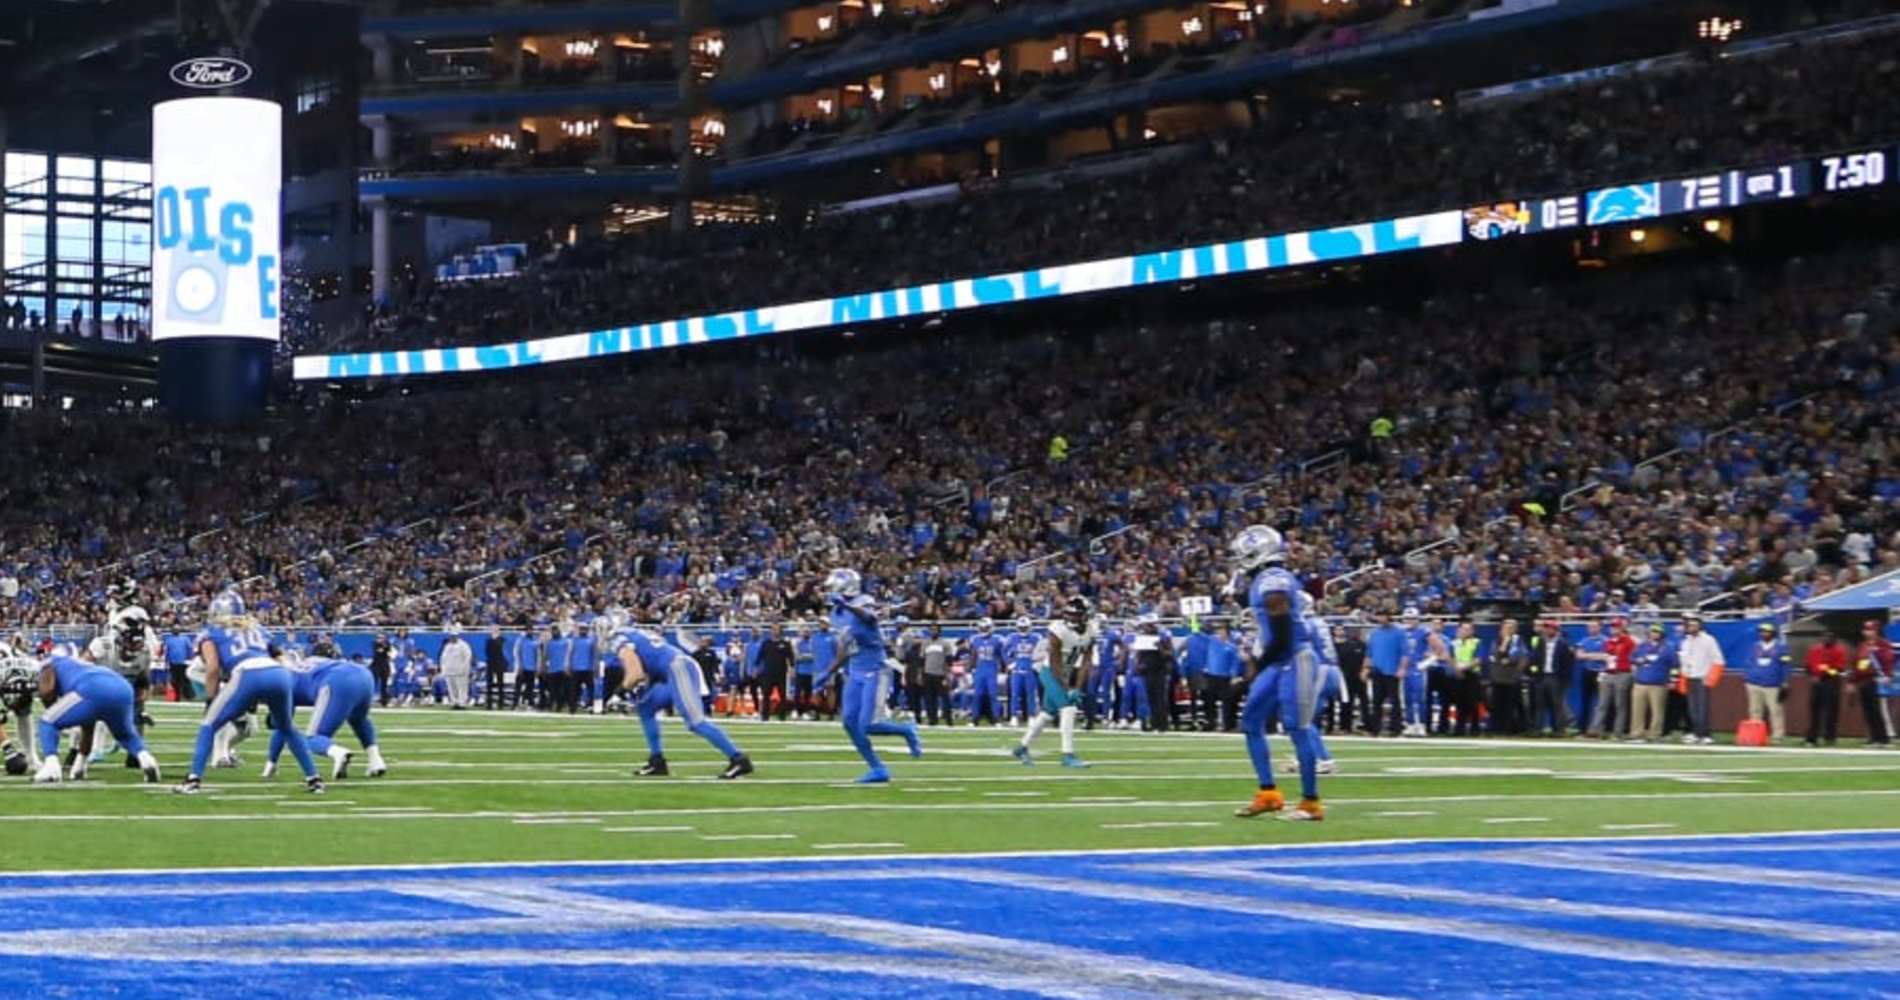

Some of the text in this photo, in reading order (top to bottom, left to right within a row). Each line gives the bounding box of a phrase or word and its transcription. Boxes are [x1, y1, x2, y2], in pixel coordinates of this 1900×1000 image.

[185, 62, 236, 83] Ford
[1681, 179, 1699, 210] 7
[1823, 151, 1885, 191] 7:50
